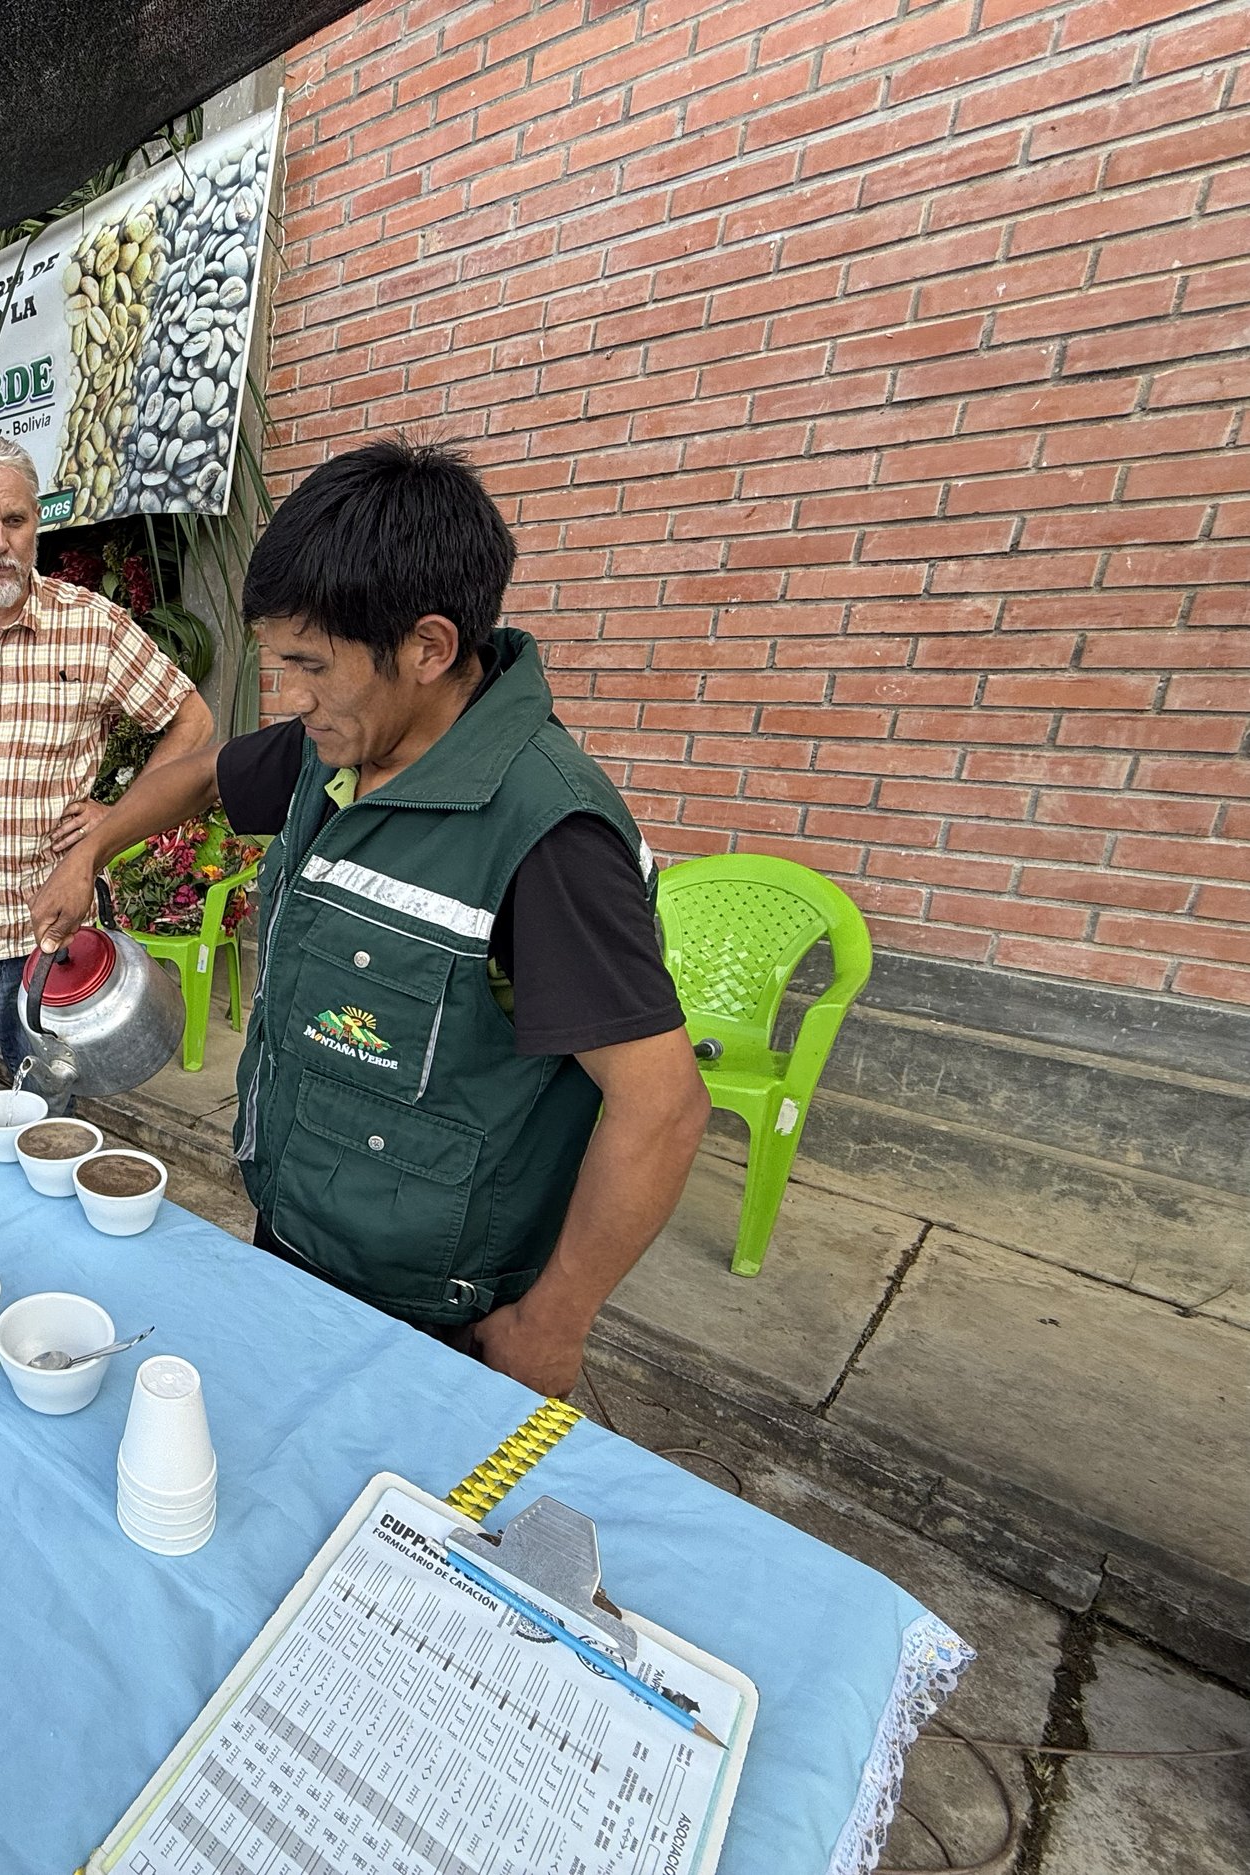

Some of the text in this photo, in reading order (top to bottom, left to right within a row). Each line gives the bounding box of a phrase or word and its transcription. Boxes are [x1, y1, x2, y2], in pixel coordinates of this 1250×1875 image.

[28, 253, 60, 281] DE
[11, 295, 37, 324] LA
[13, 413, 51, 435] Bolivia
[303, 1024, 398, 1070] MONTAÑA VERDE
[372, 1527, 434, 1571] FORMULARIO
[435, 1567, 448, 1581] DE
[449, 1576, 499, 1612] CATACIÓN
[662, 1812, 692, 1875] ASOCIACIO
